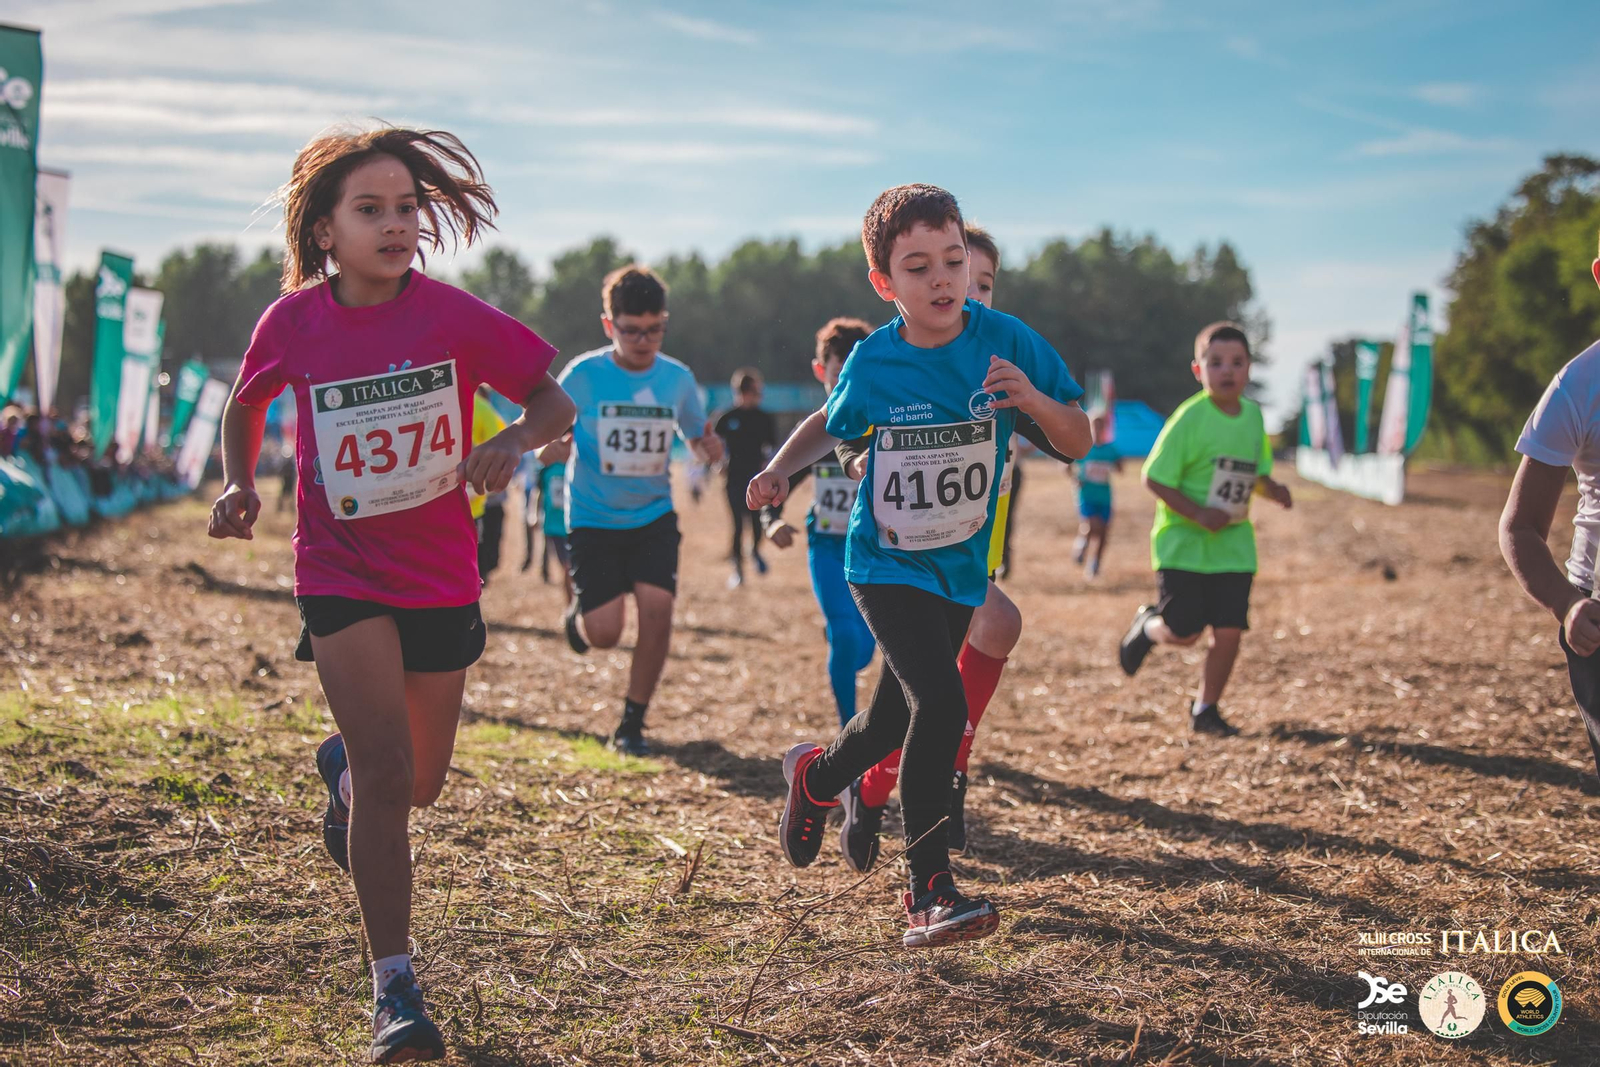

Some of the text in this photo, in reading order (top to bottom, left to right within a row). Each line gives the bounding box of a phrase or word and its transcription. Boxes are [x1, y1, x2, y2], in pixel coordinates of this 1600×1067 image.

[352, 377, 423, 402] ITÁLICA
[336, 401, 443, 428] ESCUELA DEPORTIVA SALTAMONTES
[387, 404, 402, 412] JOSÉ
[889, 402, 932, 414] Los niños
[890, 411, 933, 423] del barrio
[335, 414, 456, 478] 4374
[606, 429, 666, 453] 4311
[900, 430, 962, 447] ITÁLICA
[943, 457, 965, 465] BARRIO
[883, 462, 988, 510] 4160
[820, 487, 858, 512] 42
